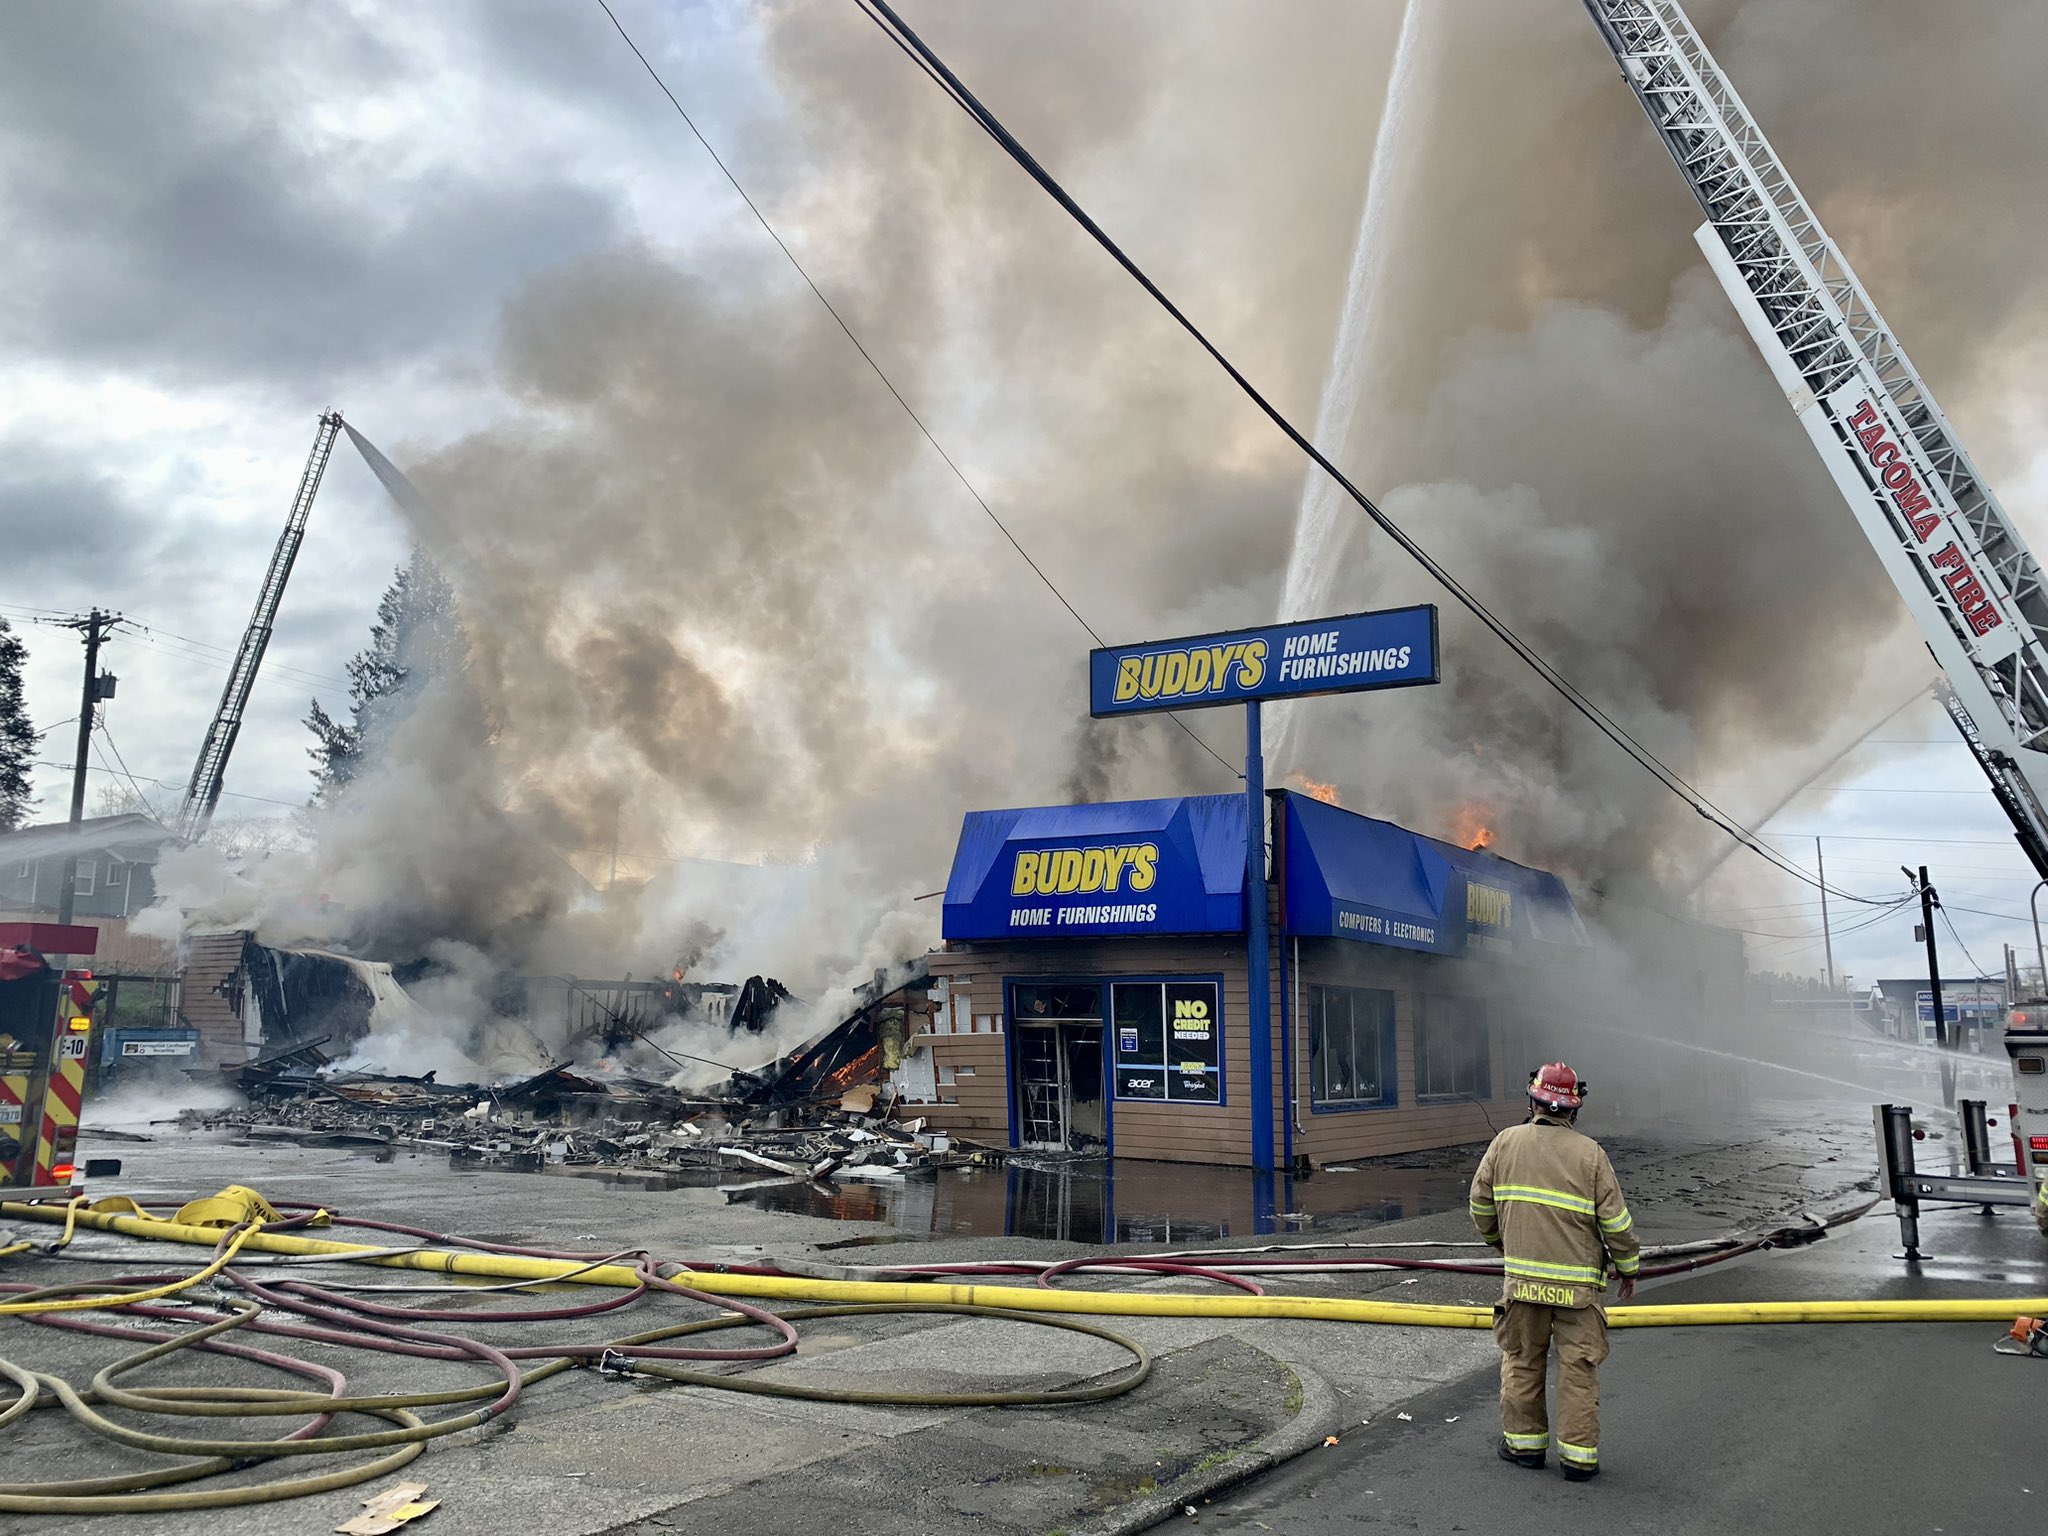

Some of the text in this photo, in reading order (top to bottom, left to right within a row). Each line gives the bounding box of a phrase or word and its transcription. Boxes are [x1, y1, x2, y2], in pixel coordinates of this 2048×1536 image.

[1846, 399, 2004, 638] TACOMA FIRE
[1283, 631, 1340, 658] HOME
[1114, 640, 1267, 701] BUDDY'S
[1279, 646, 1411, 682] FURNISHINGS
[1013, 844, 1157, 895] BUDDY'S
[1010, 903, 1157, 926] HOME FURNISHINGS
[1339, 910, 1435, 944] COMPUTERS & ELECTRONICS
[1175, 1000, 1208, 1019] NO
[1173, 1018, 1211, 1031] CREDIT
[1174, 1031, 1210, 1040] NEEDED
[1128, 1079, 1154, 1088] acer
[1543, 1083, 1570, 1094] JACKSON
[1513, 1280, 1574, 1306] JACKSON
